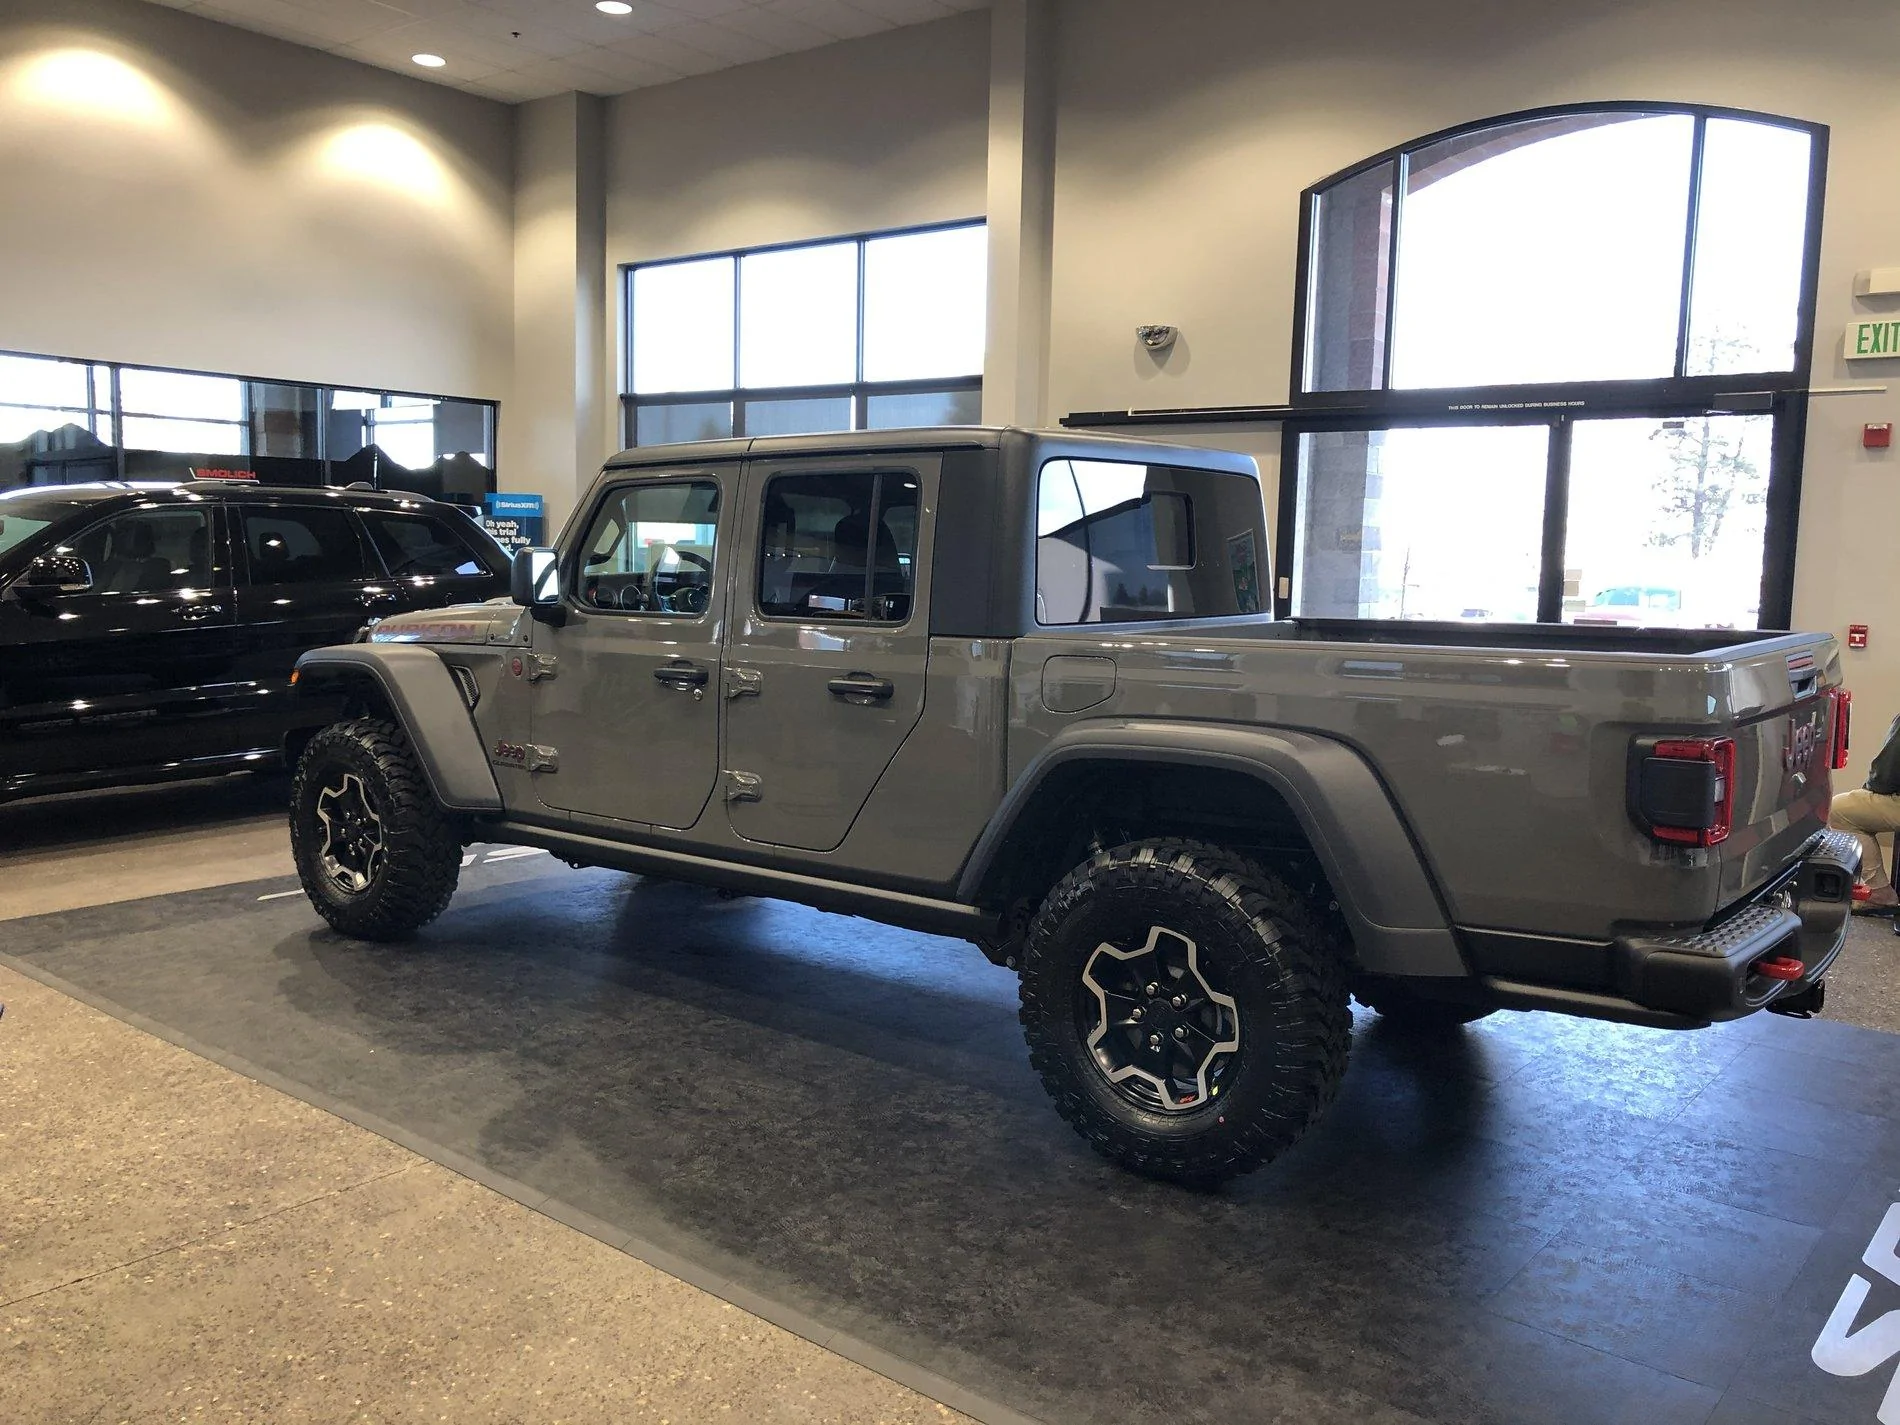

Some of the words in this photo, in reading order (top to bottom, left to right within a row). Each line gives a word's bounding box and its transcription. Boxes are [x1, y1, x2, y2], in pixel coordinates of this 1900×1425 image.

[1857, 323, 1900, 353] EXIT
[196, 468, 256, 479] SMOLICH
[496, 520, 519, 529] yeah,
[499, 528, 517, 536] trial
[511, 536, 531, 546] fully
